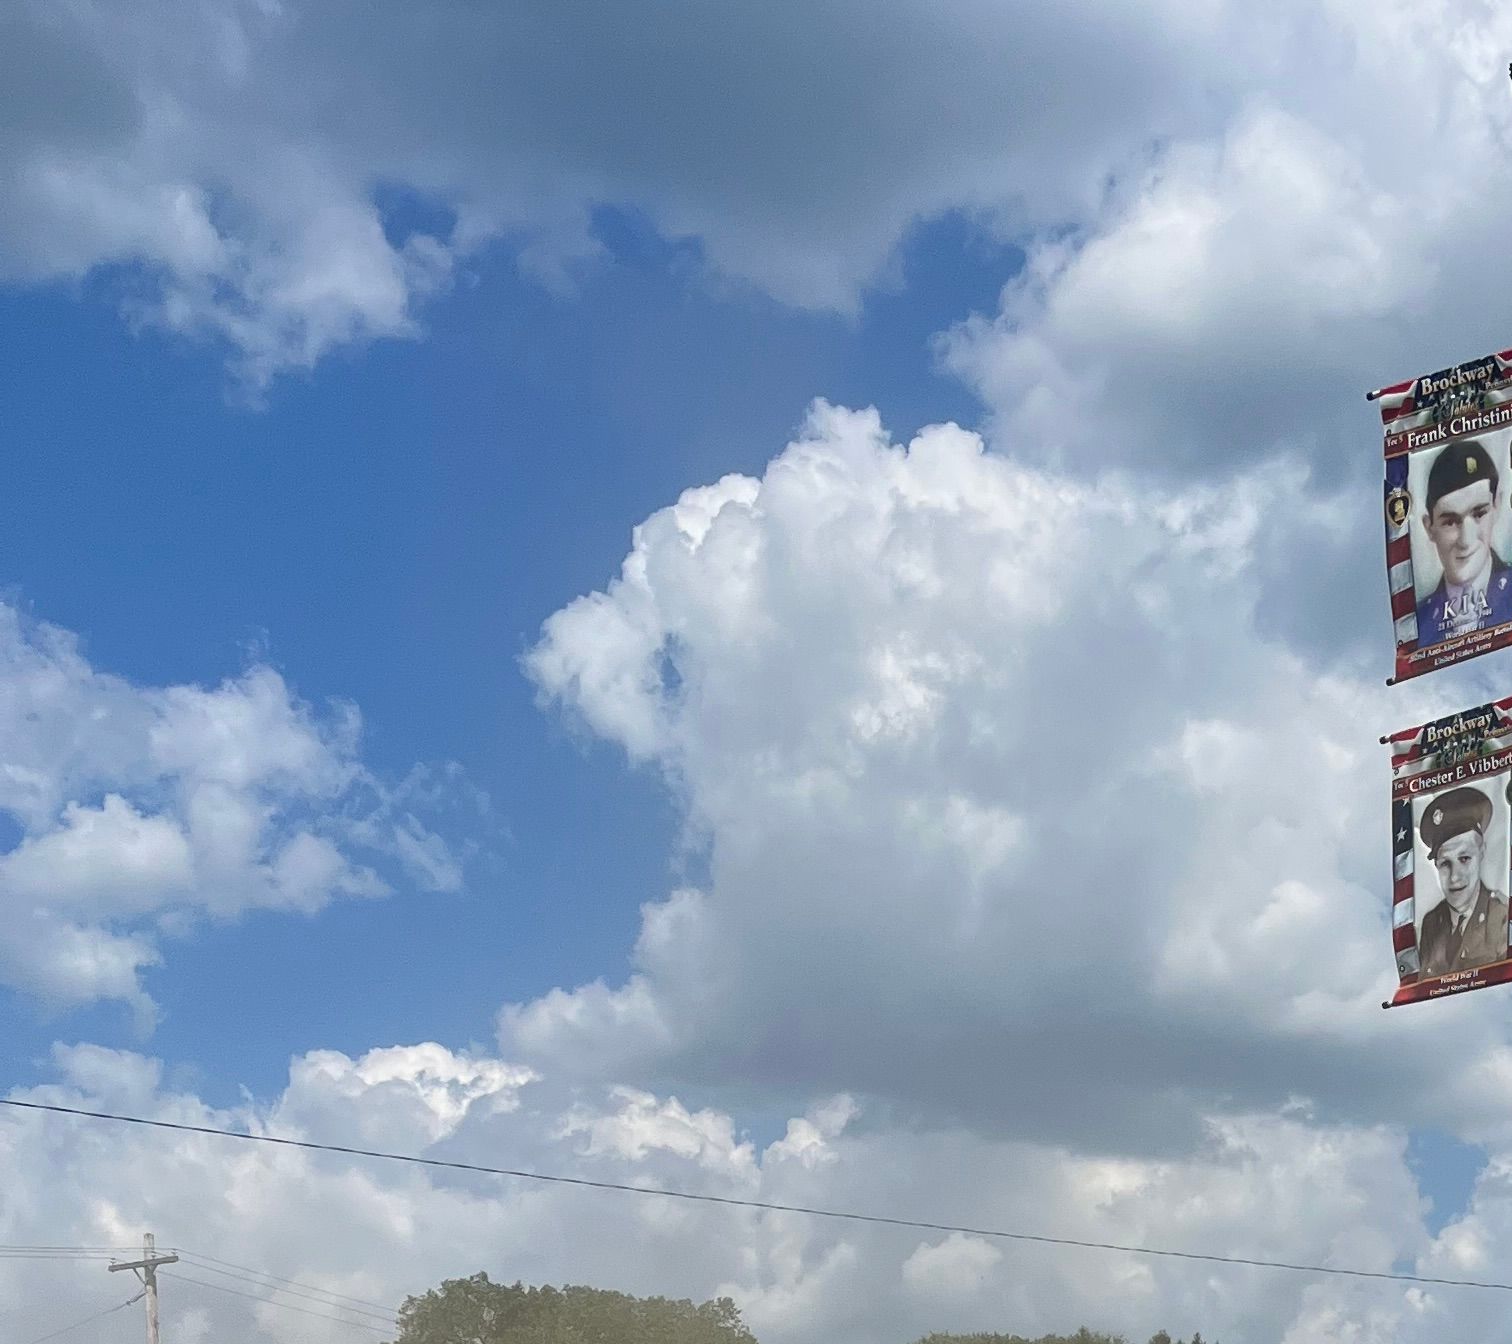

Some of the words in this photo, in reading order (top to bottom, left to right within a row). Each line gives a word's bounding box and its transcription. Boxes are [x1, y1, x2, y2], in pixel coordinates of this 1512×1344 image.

[1421, 363, 1495, 396] Brockway
[1407, 423, 1447, 449] Frank
[1466, 631, 1493, 645] Artillery
[1434, 652, 1455, 665] United
[1456, 647, 1474, 658] States
[1475, 642, 1492, 652] Army
[1427, 712, 1493, 743] Brockway
[1409, 771, 1454, 793] Chester
[1440, 973, 1459, 984] World
